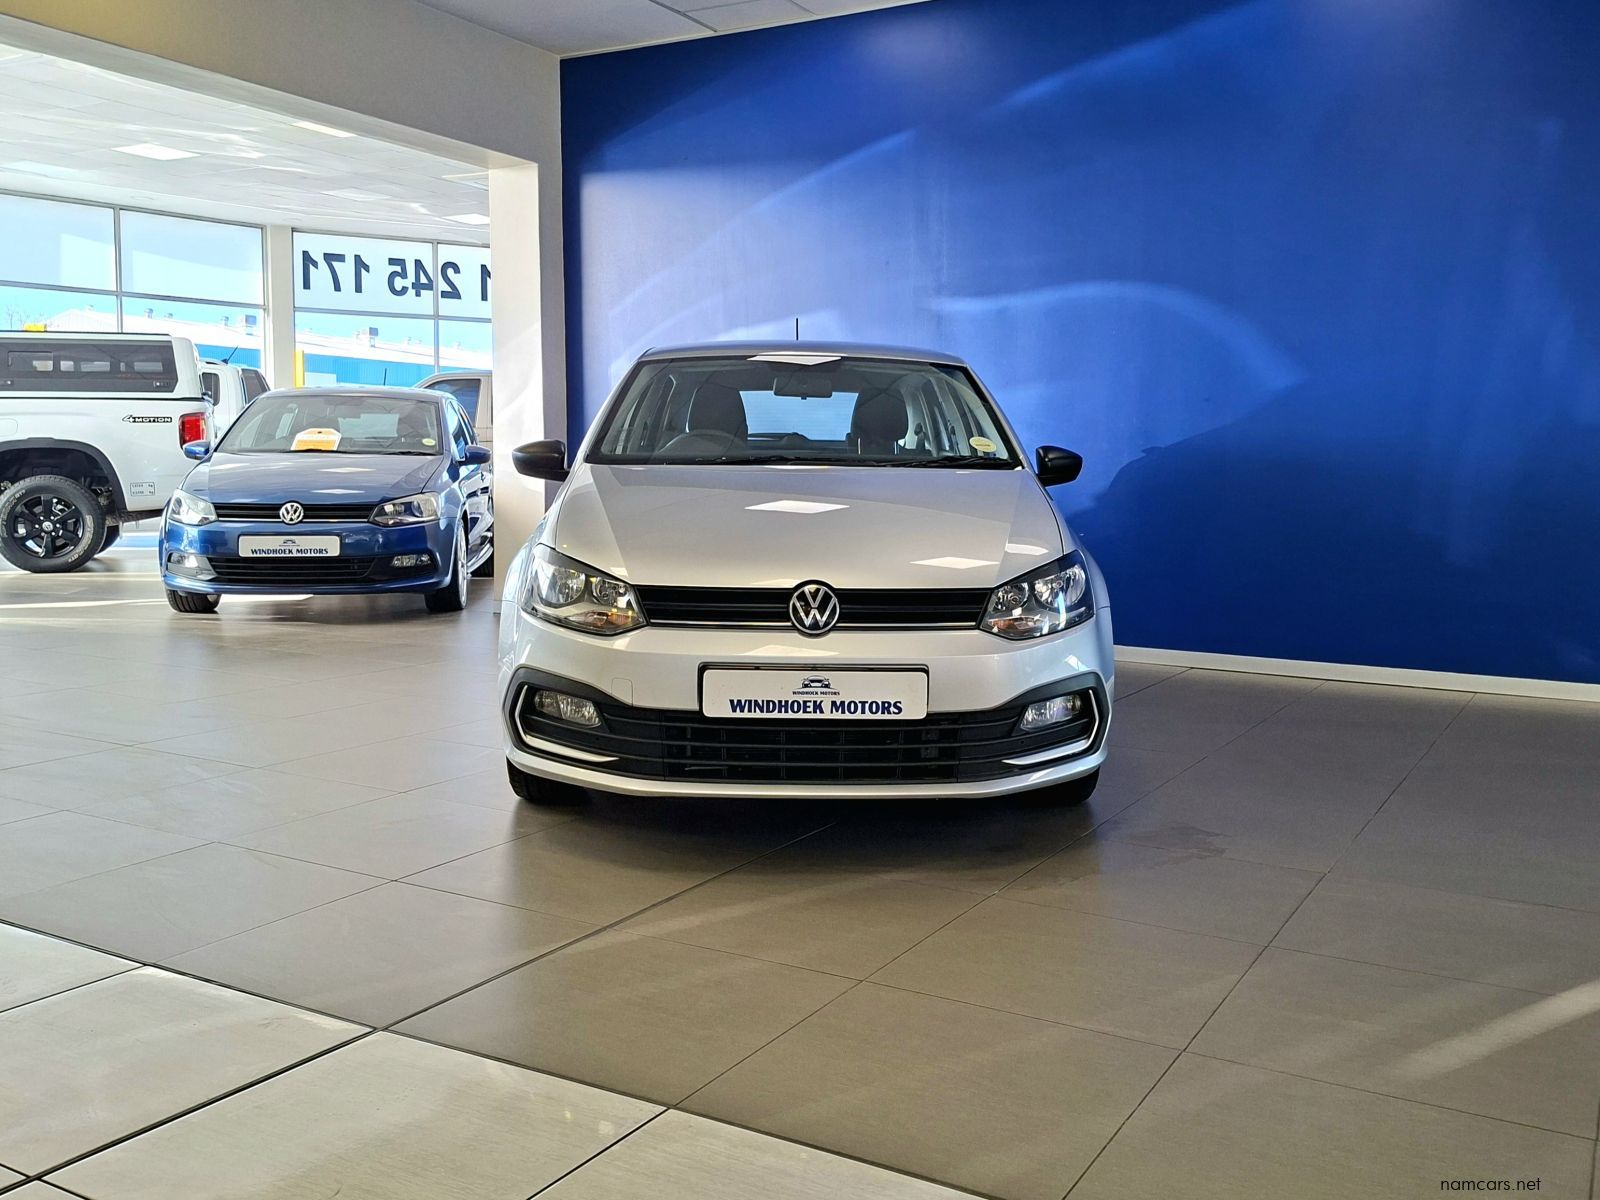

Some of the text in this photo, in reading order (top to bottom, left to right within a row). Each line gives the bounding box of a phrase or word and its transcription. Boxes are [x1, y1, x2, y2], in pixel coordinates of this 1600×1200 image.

[122, 414, 173, 423] 4MOTION
[790, 584, 839, 632] VW
[729, 698, 903, 715] WINDHOEK MOTORS
